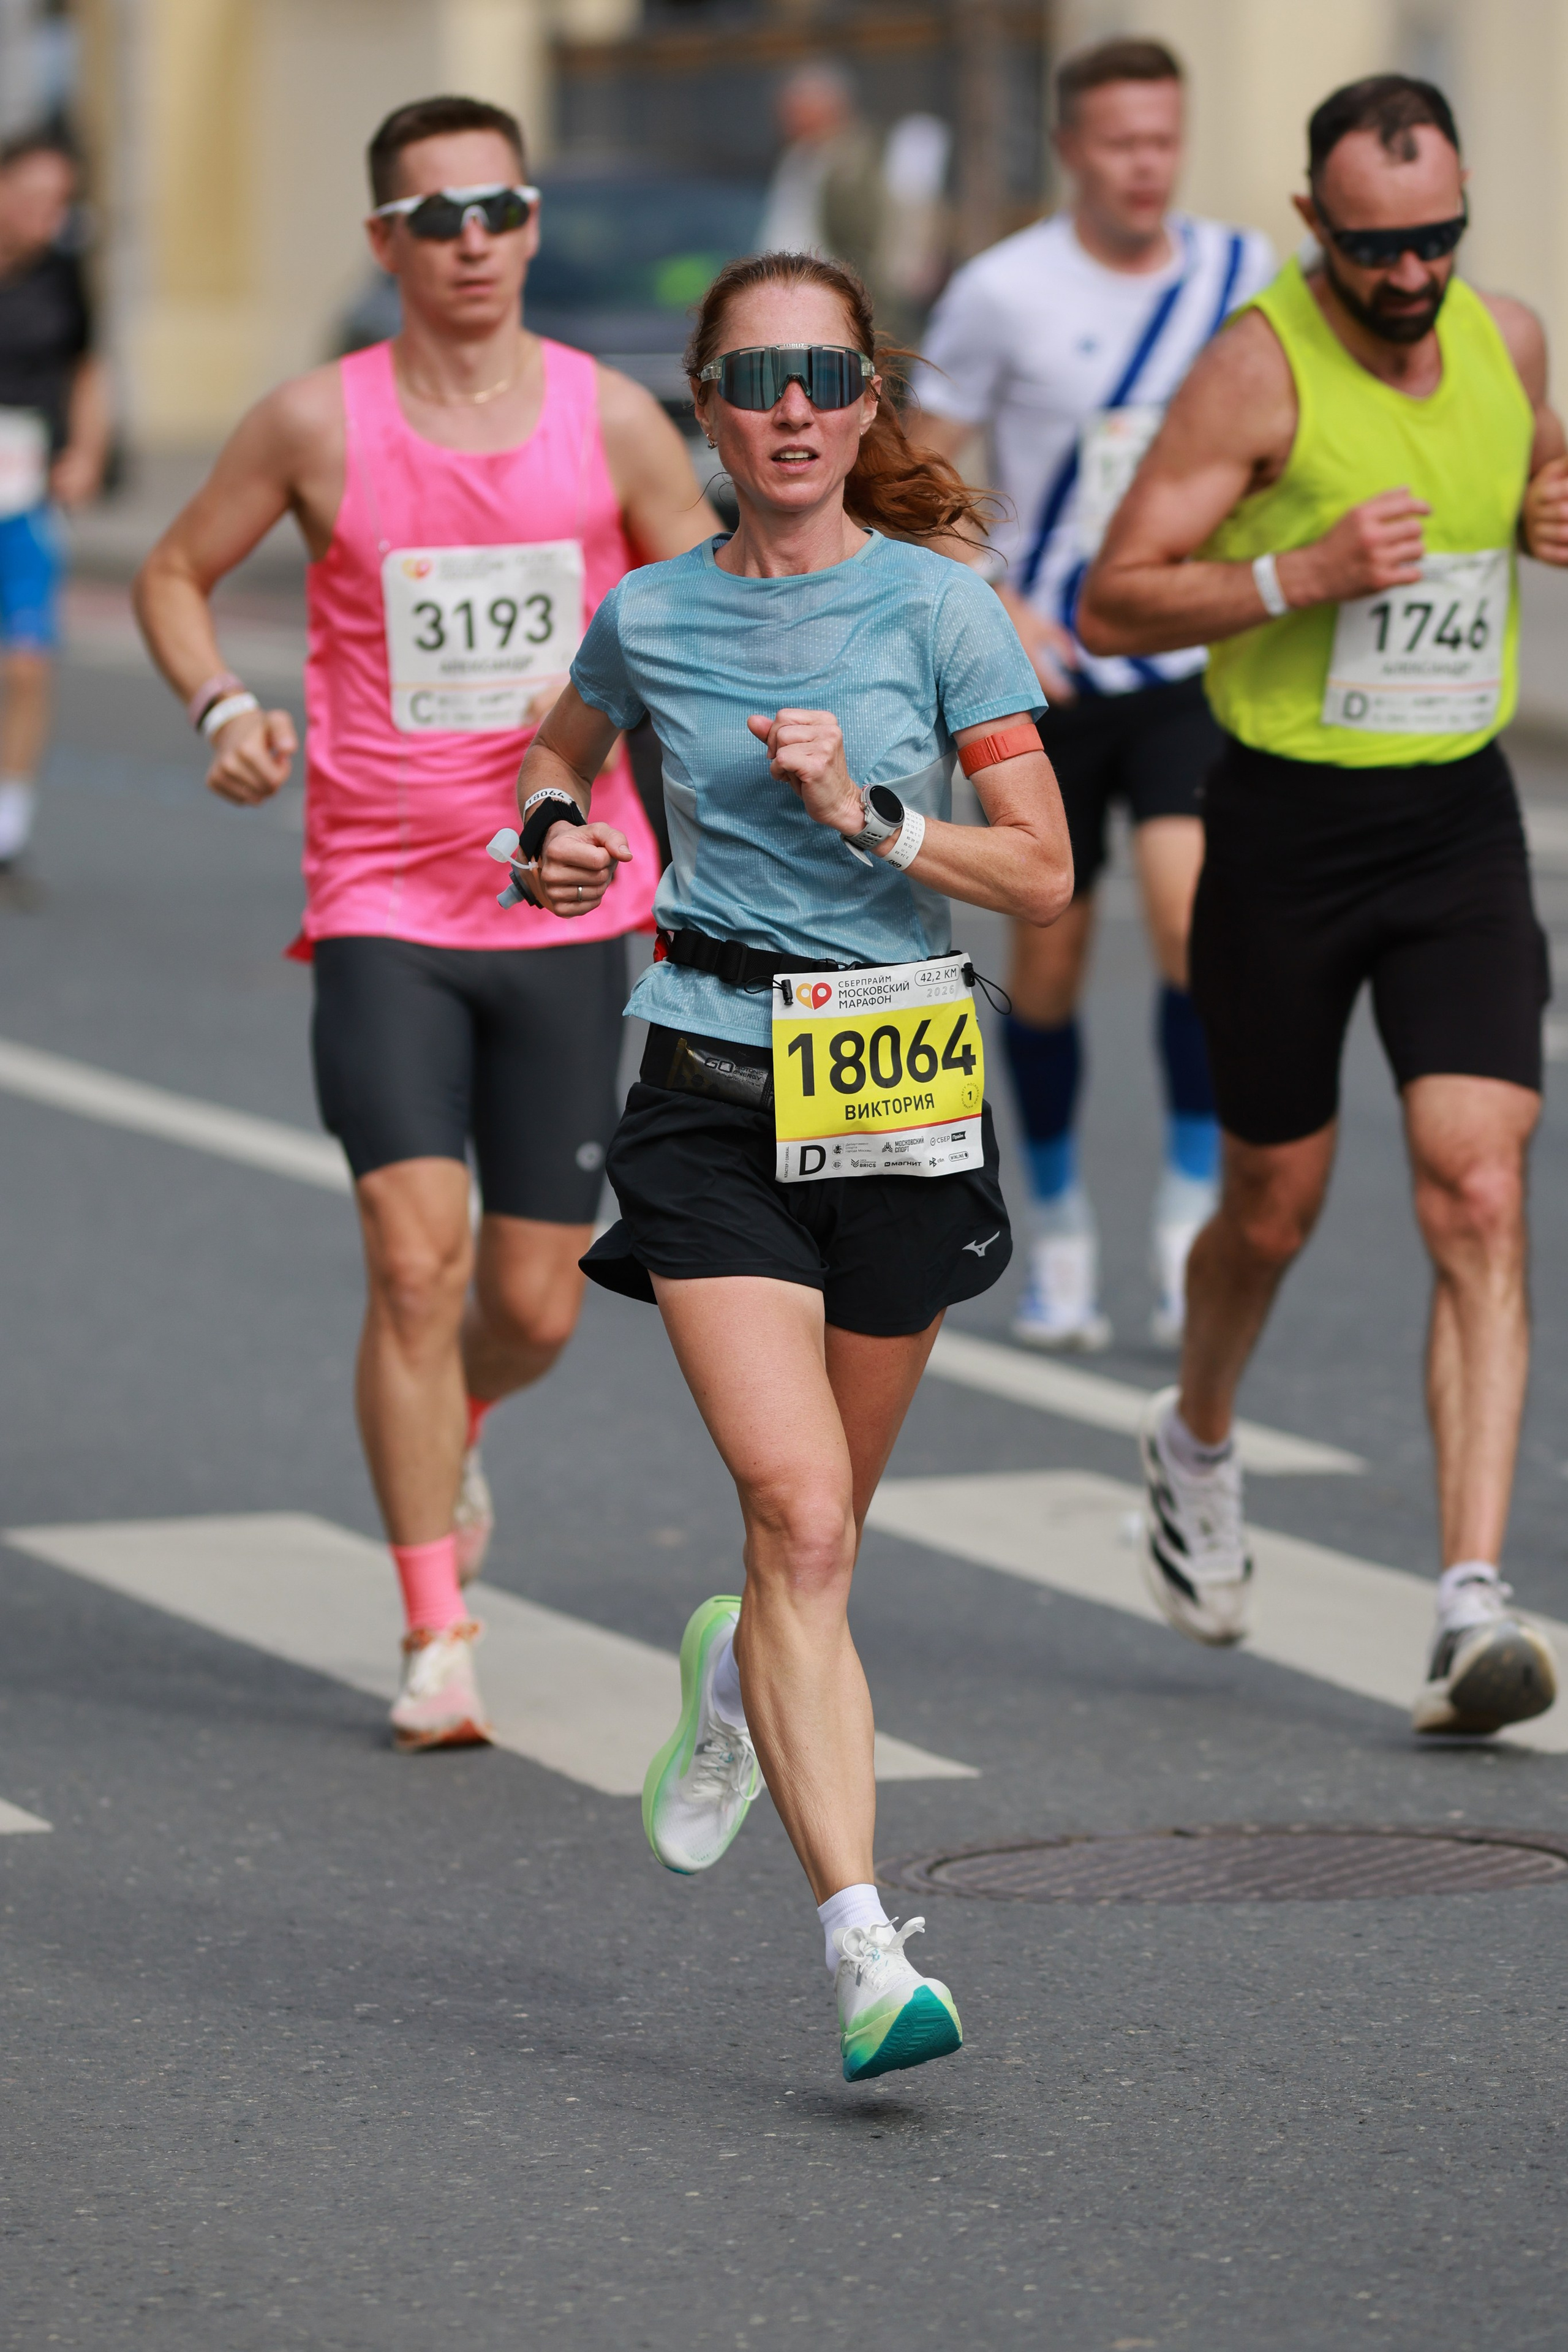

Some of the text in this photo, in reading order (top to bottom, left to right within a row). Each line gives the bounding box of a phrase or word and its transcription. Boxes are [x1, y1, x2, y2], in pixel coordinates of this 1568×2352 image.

[413, 593, 554, 652] 3193
[1370, 598, 1488, 652] 1746
[527, 790, 565, 805] 18064
[838, 976, 892, 988] СБЕРПРАЙМ
[921, 971, 941, 982] 42,2
[839, 981, 910, 998] МОСКОВСКИЙ
[927, 985, 955, 998] 2026
[839, 995, 892, 1009] МАРАФОН
[788, 1013, 976, 1097] 18064
[704, 1057, 734, 1073] GO
[968, 1091, 972, 1101] 1
[845, 1093, 935, 1120] ВИКТОРИЯ
[895, 1136, 924, 1147] МОСКОВСКИЙ
[799, 1145, 826, 1175] D
